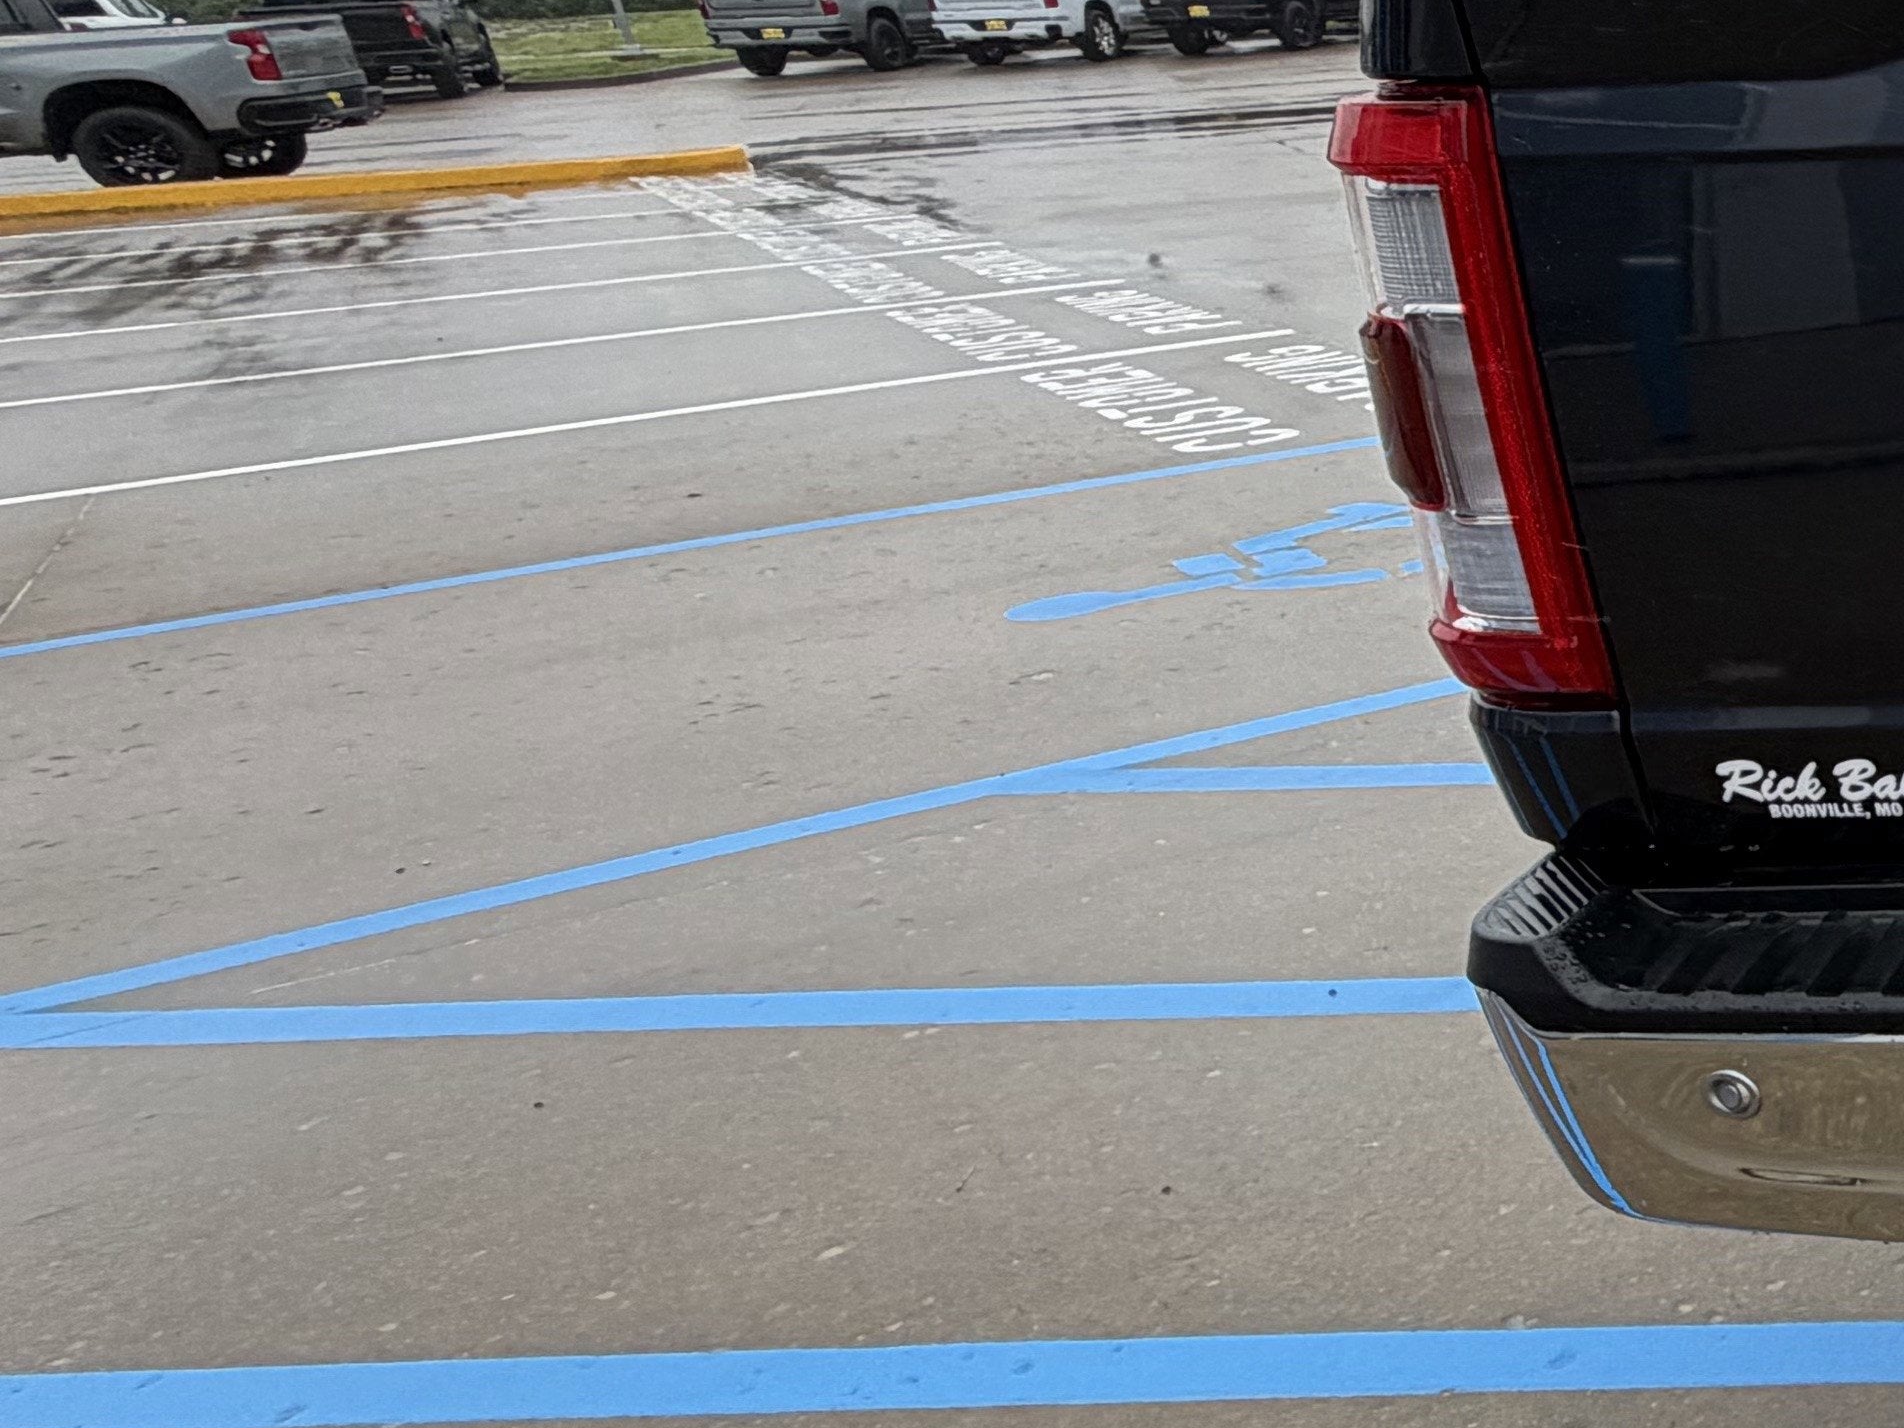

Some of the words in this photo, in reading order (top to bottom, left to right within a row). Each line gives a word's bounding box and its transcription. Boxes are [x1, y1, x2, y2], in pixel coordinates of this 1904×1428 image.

[1224, 344, 1375, 412] RKING
[1020, 362, 1300, 452] CUSTOMER
[1715, 759, 1826, 803] Rick
[1768, 803, 1872, 819] BOONVILLE,
[1874, 802, 1904, 817] MO
